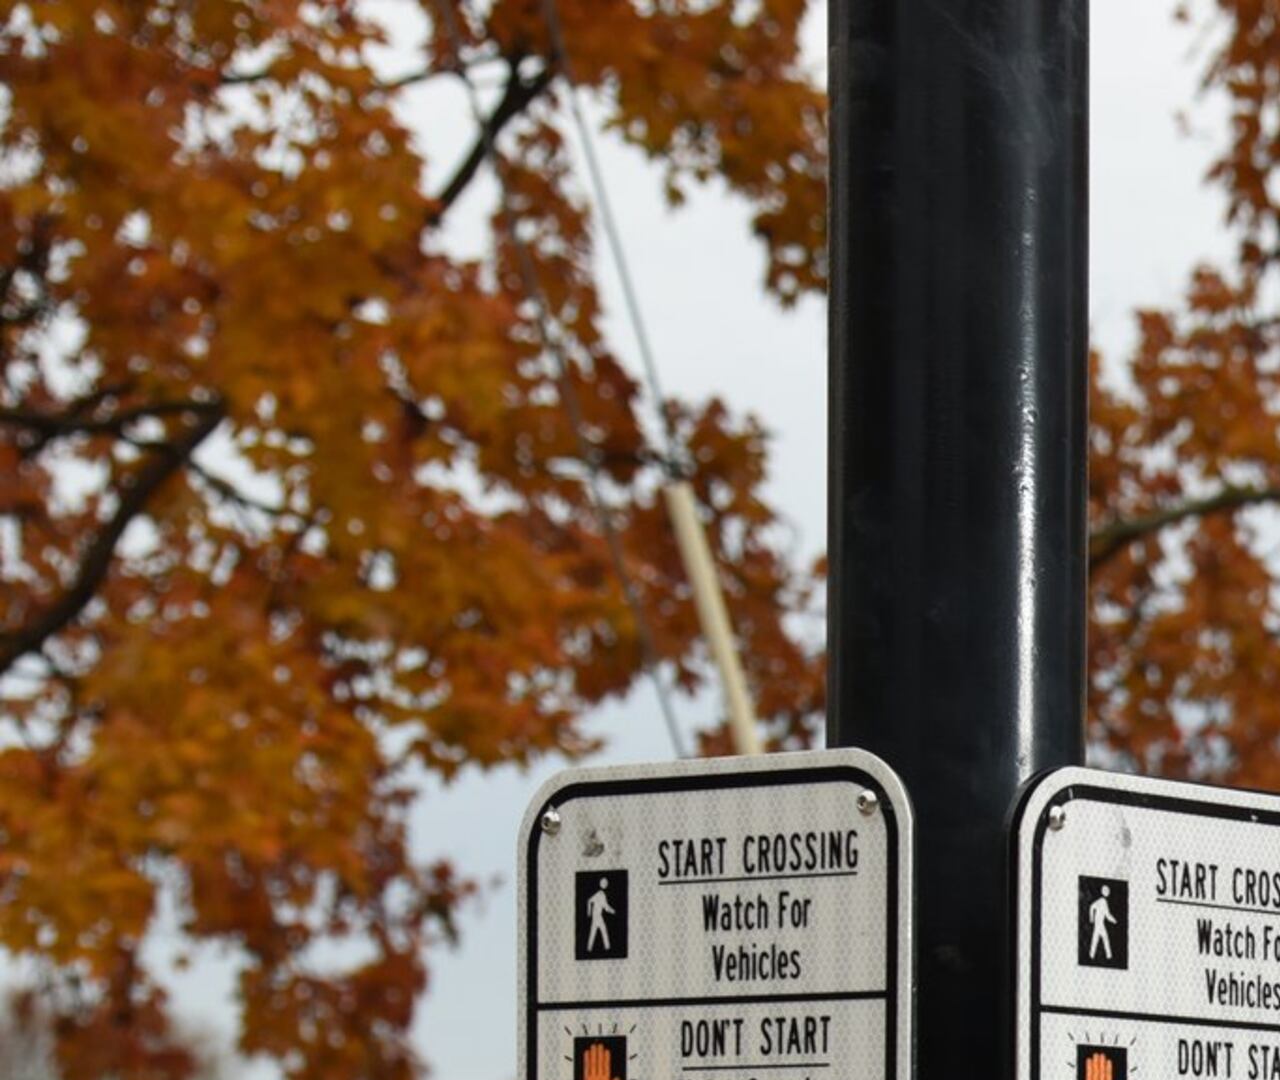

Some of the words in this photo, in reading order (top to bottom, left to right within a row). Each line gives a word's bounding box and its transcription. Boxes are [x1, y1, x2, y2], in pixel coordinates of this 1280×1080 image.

[657, 837, 727, 878] START
[742, 830, 859, 873] CROSSING
[1155, 858, 1219, 901] START
[702, 893, 769, 932] Watch
[778, 890, 811, 930] For
[1197, 918, 1257, 959] Watch
[712, 944, 802, 982] Vehicles
[681, 1017, 744, 1058] DON'T
[760, 1015, 831, 1056] START
[1178, 1038, 1235, 1078] DON'T
